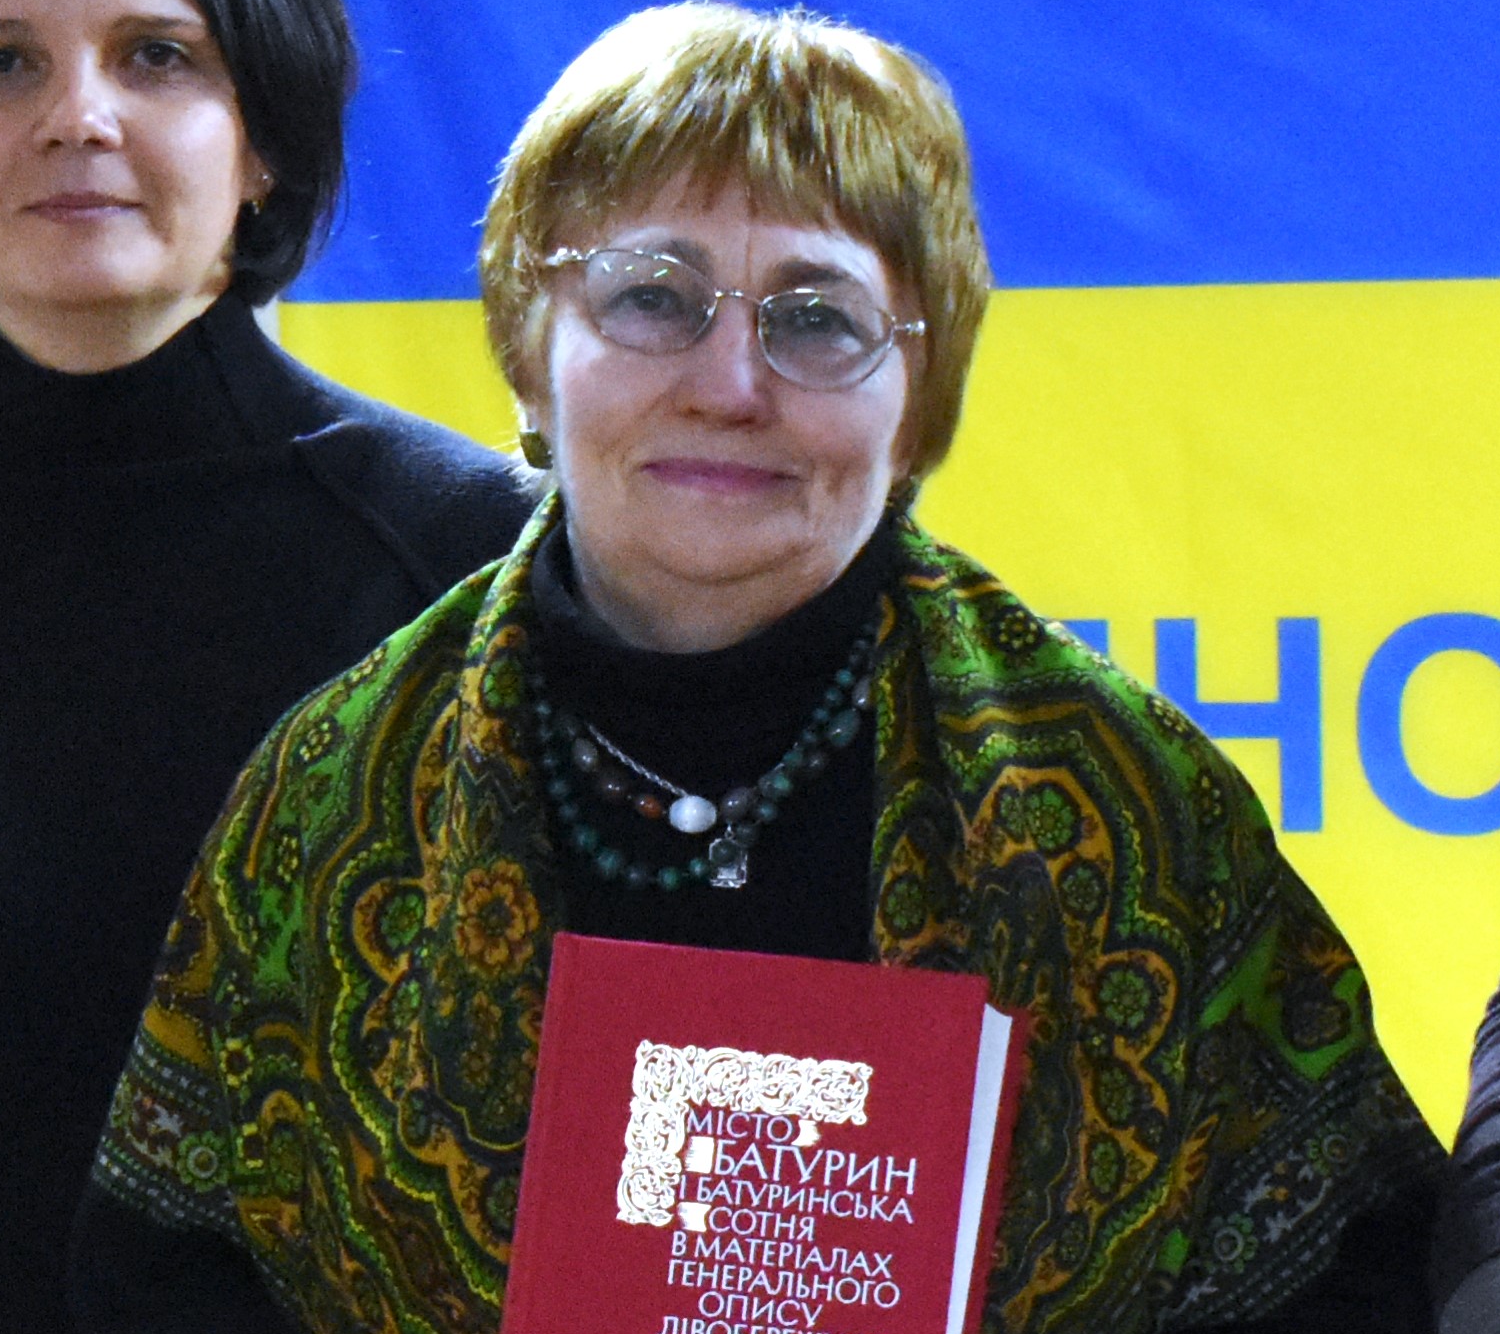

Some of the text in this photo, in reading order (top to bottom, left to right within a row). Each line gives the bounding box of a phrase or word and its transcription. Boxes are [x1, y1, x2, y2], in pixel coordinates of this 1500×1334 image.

[687, 1110, 793, 1142] МІСТО
[714, 1139, 917, 1195] БАТУРИН
[679, 1175, 914, 1224] І БАТУРИНСЬКА
[708, 1206, 815, 1242] СОТНЯ
[672, 1231, 893, 1279] В МАТЕРІАЛАХ
[667, 1259, 900, 1308] ГЕНЕРАЛЬНОГО
[698, 1291, 823, 1328] ОПИСУ
